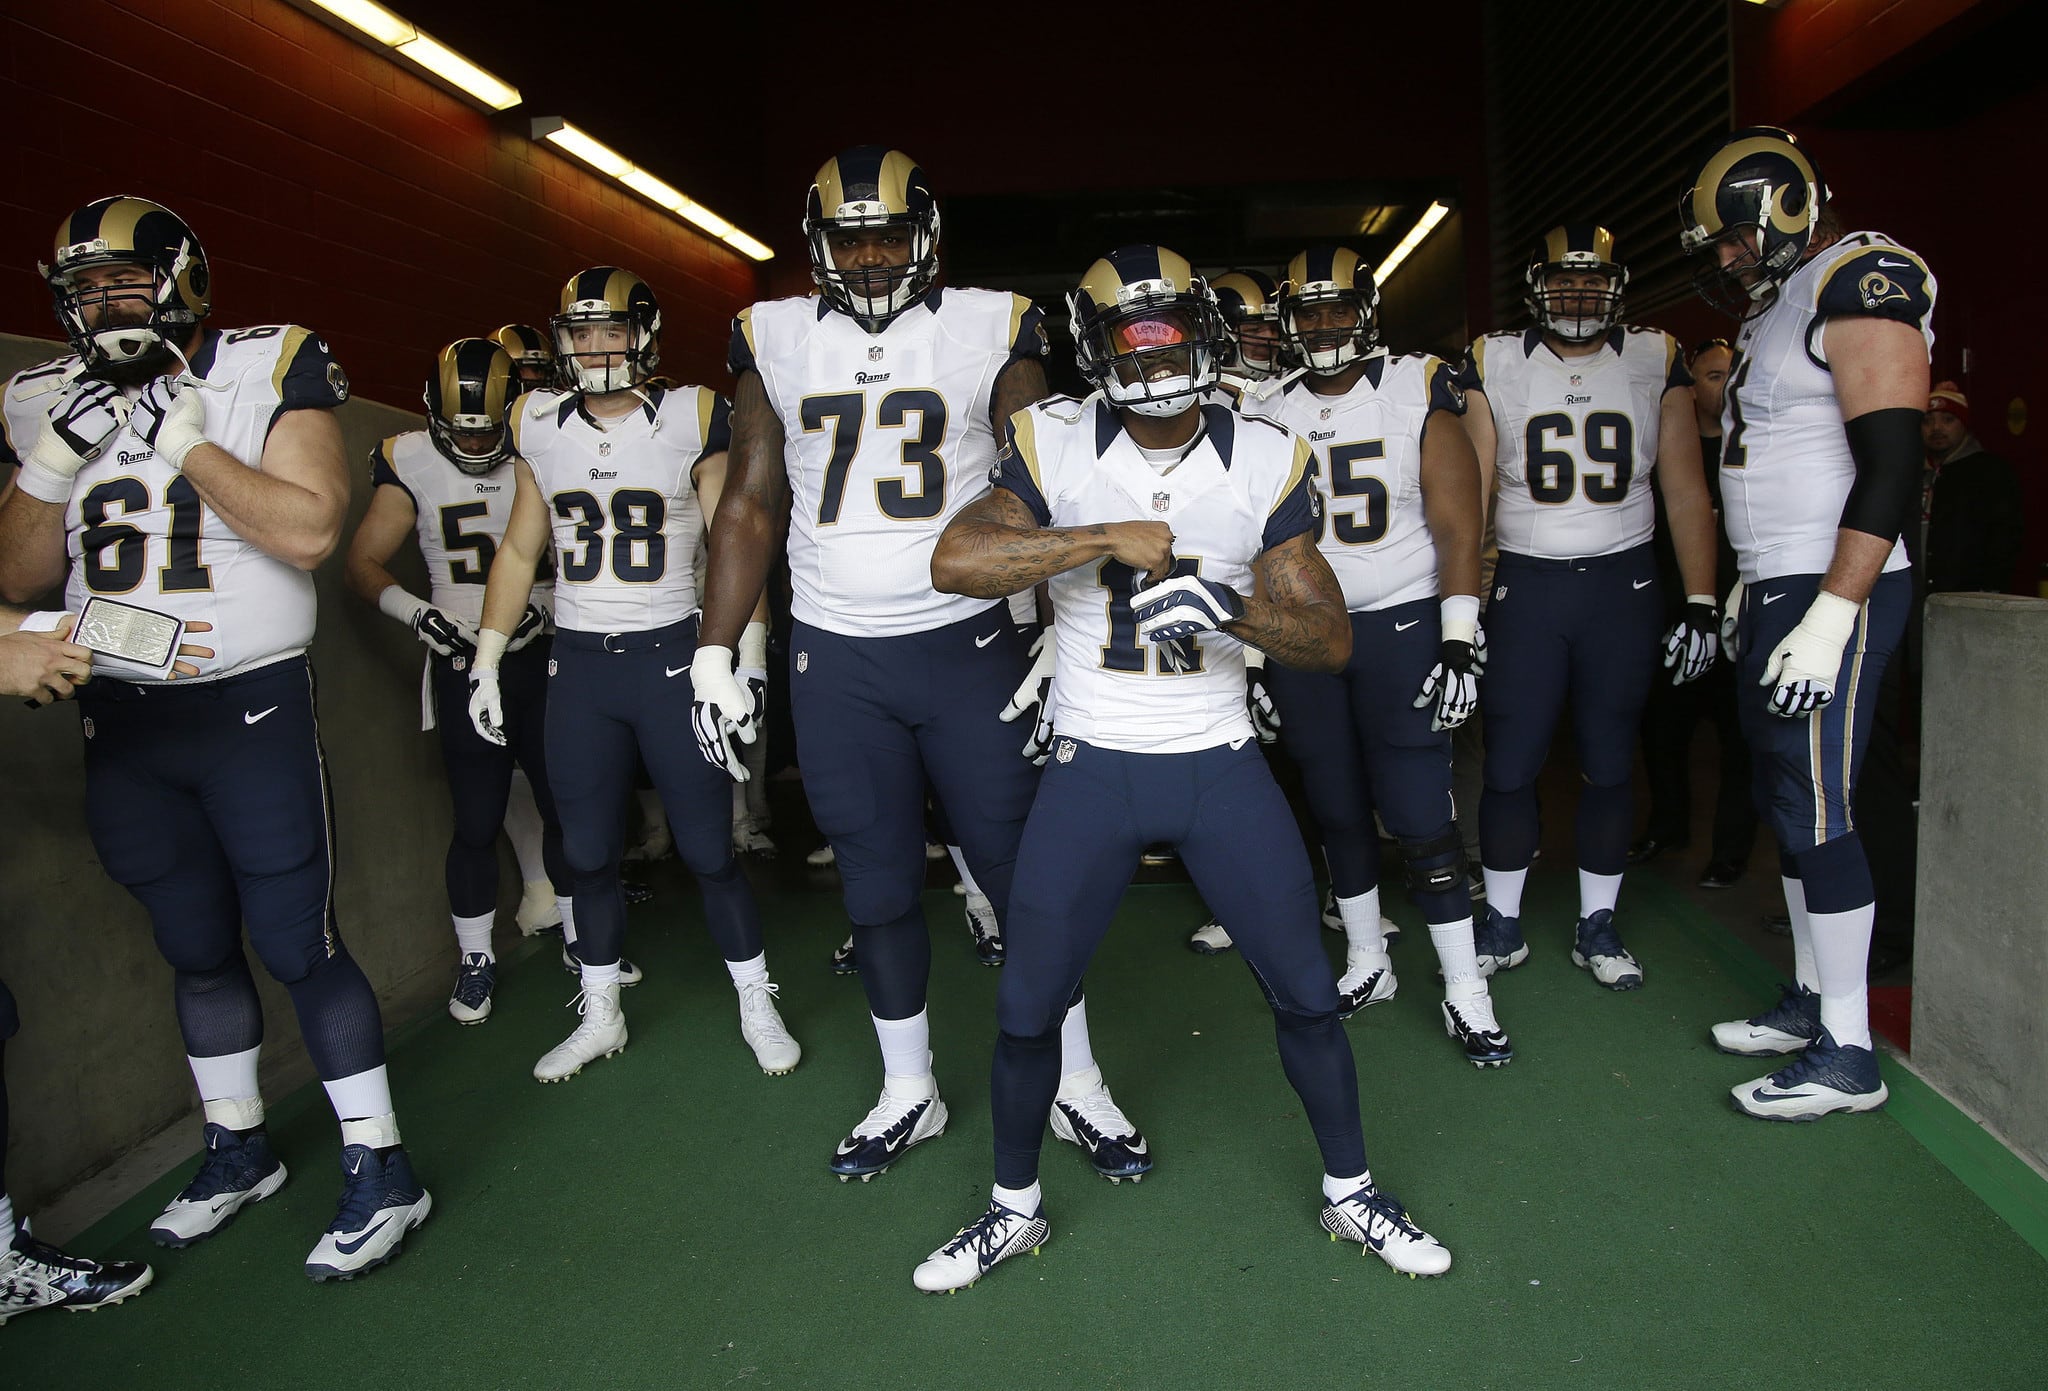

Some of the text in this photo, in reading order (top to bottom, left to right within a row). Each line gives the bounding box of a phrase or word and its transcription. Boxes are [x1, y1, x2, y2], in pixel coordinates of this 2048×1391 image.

[855, 371, 891, 385] Rams
[1565, 394, 1592, 406] Rams
[1308, 430, 1337, 443] Rams
[117, 450, 154, 466] Rams
[798, 387, 949, 528] 73
[1524, 410, 1635, 507] 69
[589, 468, 618, 481] Rams
[474, 483, 502, 494] Rams
[80, 473, 213, 595] 61
[552, 487, 668, 585] 38
